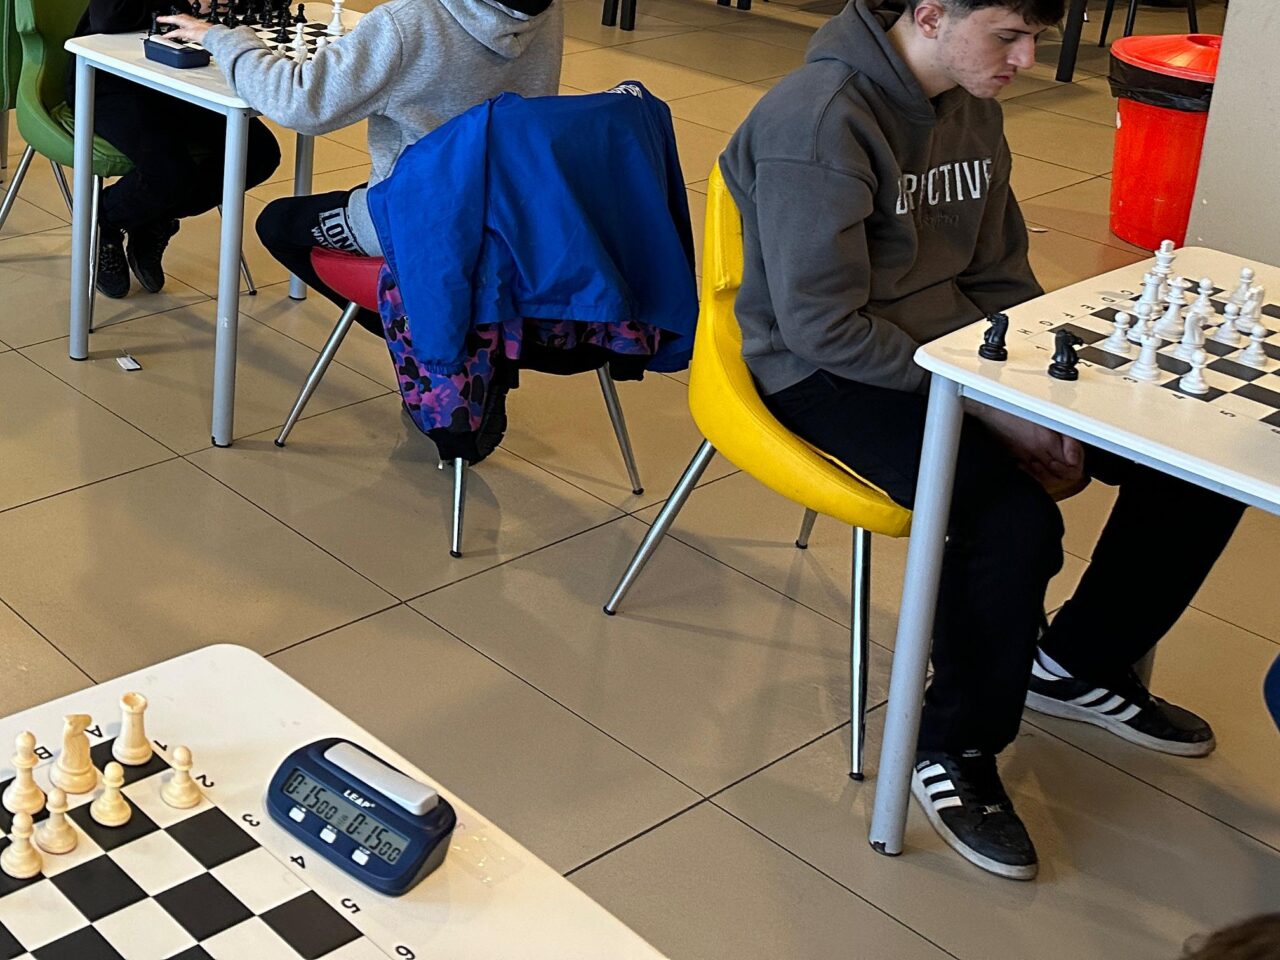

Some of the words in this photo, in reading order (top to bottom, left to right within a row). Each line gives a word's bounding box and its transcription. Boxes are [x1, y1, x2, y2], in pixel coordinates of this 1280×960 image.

[85, 724, 103, 738] A
[34, 746, 53, 760] B
[154, 740, 168, 752] 1
[196, 774, 214, 788] 2
[343, 790, 370, 808] LEAP
[242, 813, 260, 827] 3
[290, 855, 306, 869] 4
[341, 898, 361, 914] 5
